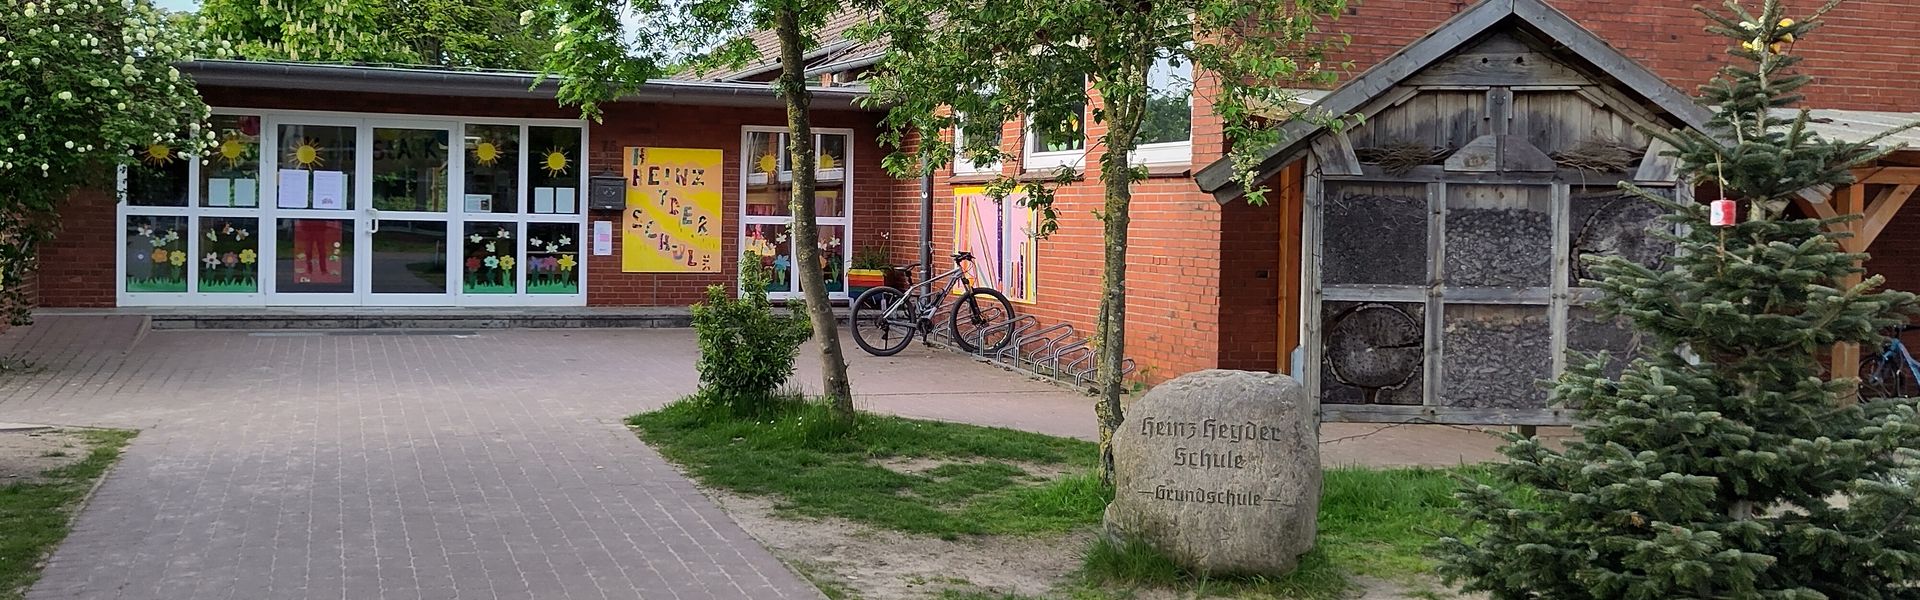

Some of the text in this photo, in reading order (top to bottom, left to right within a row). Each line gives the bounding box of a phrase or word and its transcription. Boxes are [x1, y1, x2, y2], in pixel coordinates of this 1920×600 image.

[1141, 416, 1281, 443] Heinz Heyder
[1173, 447, 1244, 471] Schule
